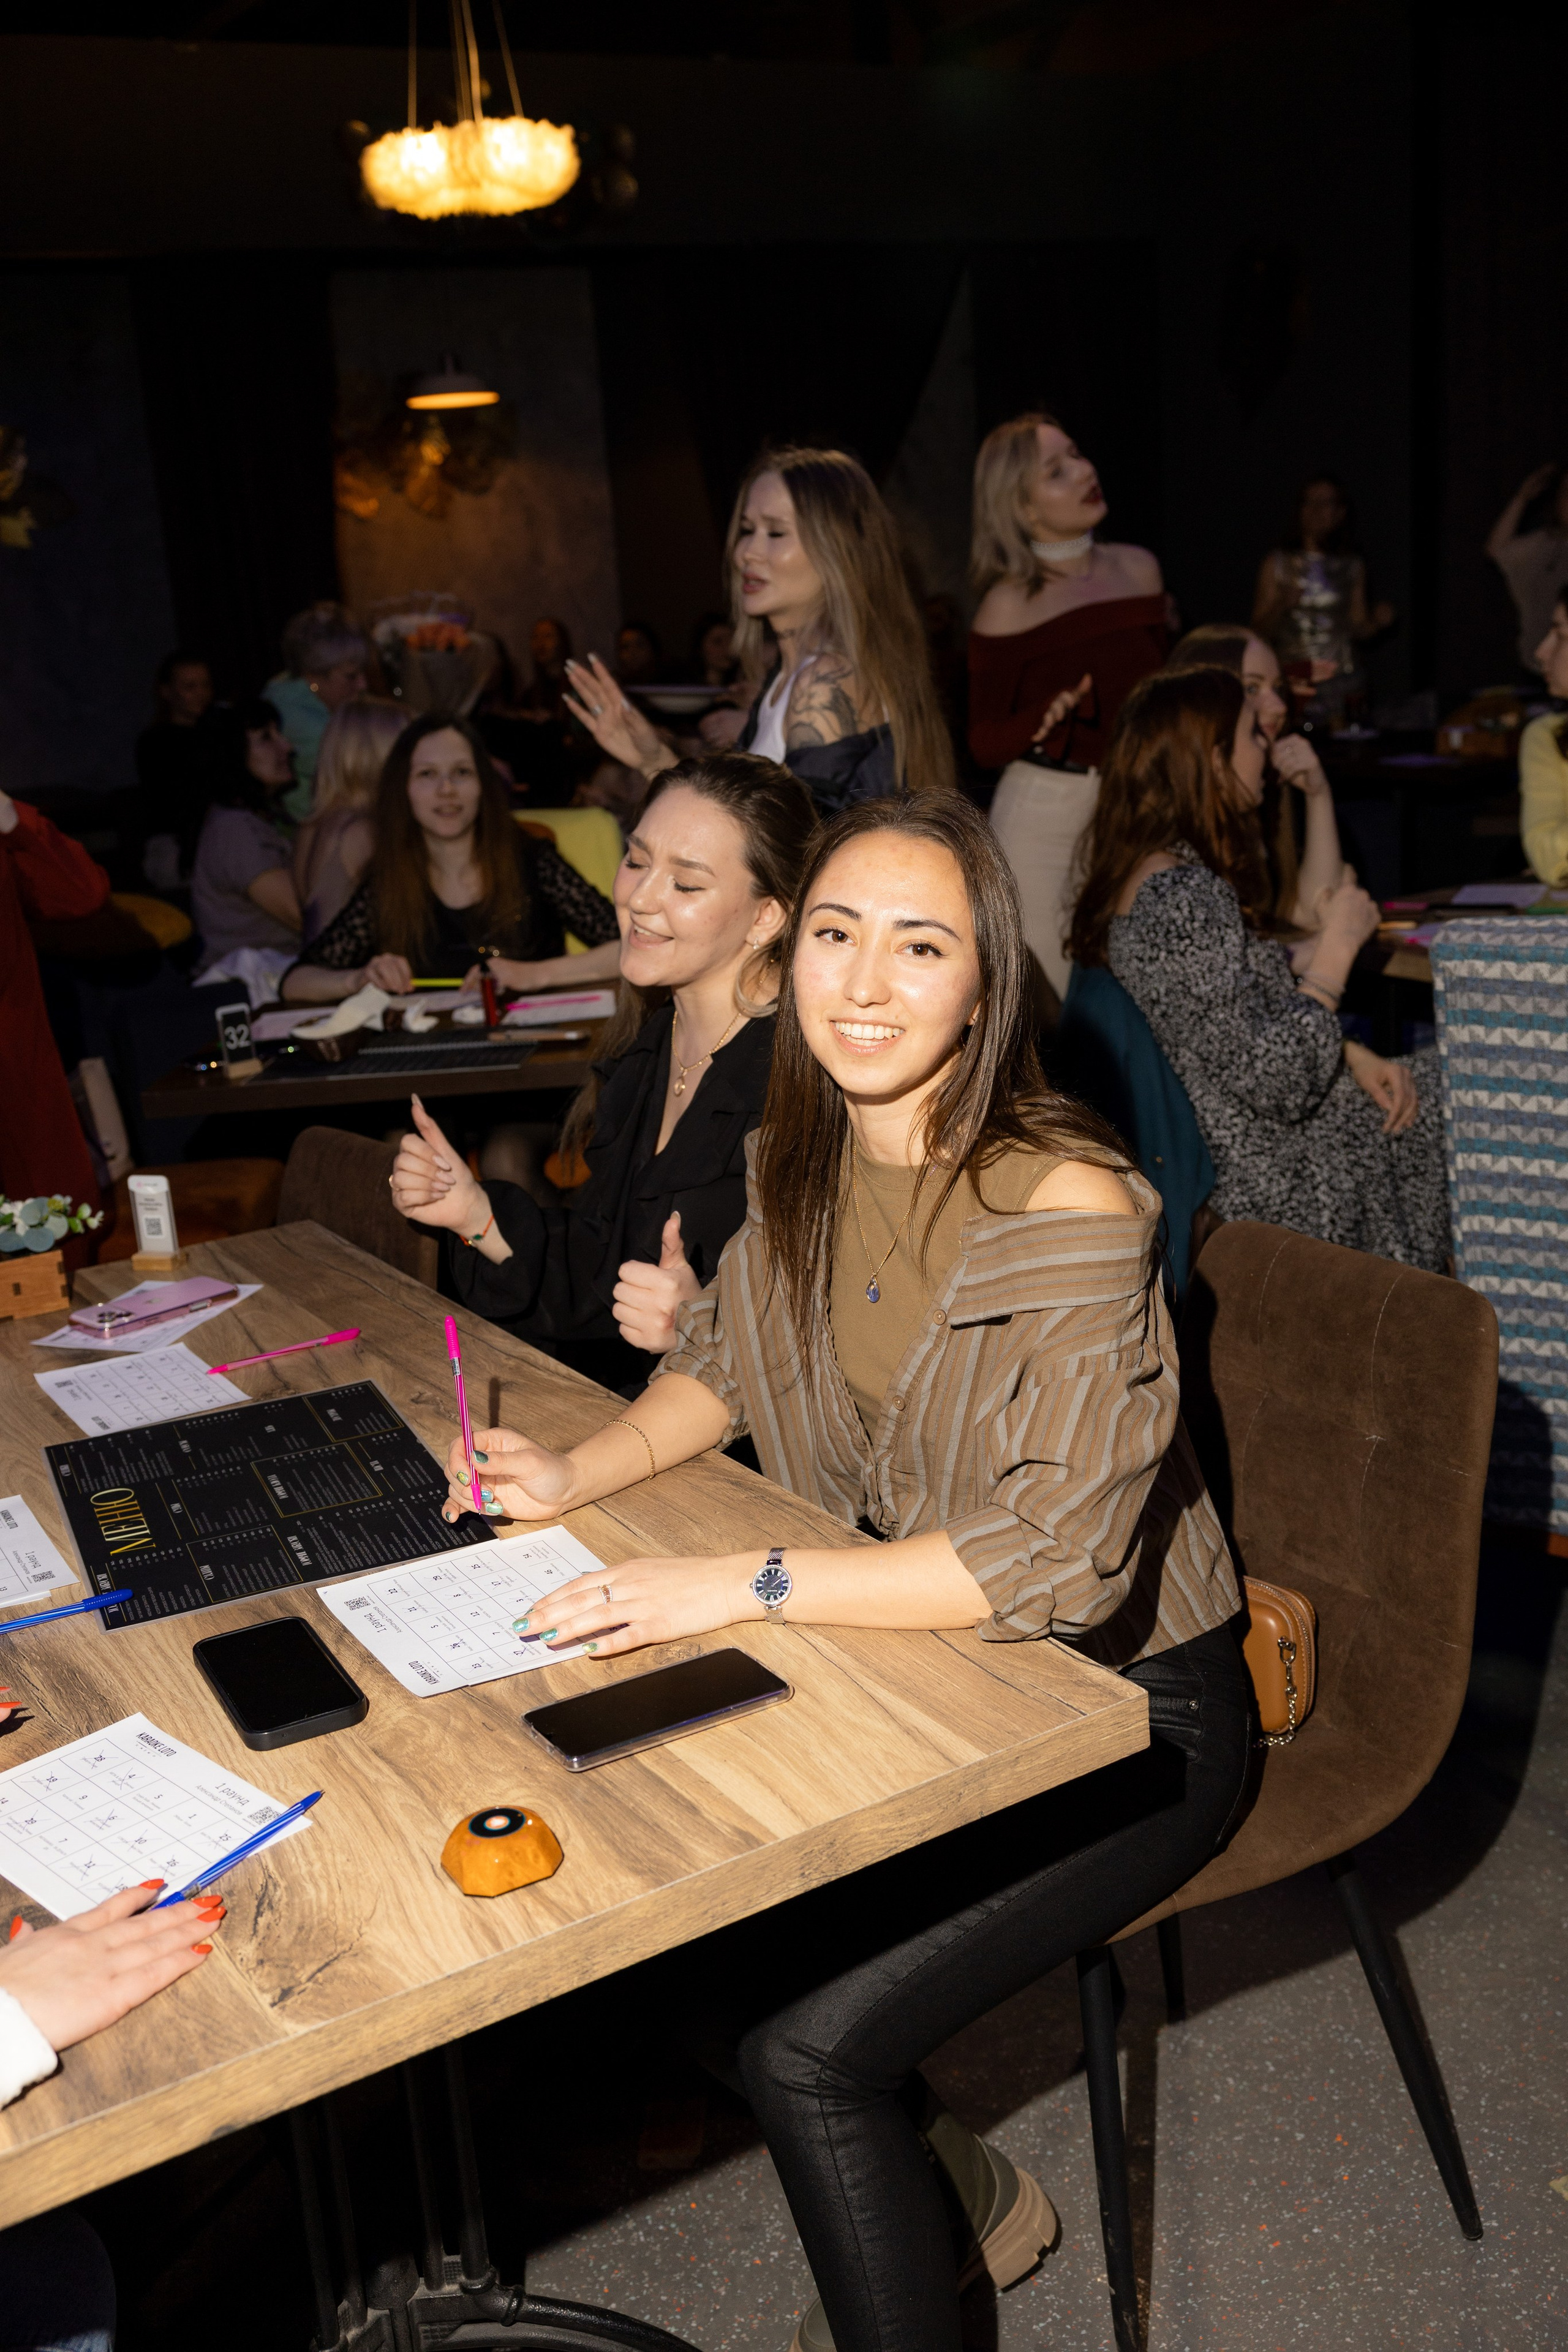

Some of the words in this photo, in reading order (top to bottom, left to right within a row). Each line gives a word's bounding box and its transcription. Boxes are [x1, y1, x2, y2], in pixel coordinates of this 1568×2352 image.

[224, 1023, 251, 1050] 32
[7, 1520, 18, 1529] LOTO
[90, 1488, 156, 1556] МЕНЮ
[287, 1536, 304, 1550] ЗАКУСКИ
[25, 1555, 41, 1569] раунд
[295, 1551, 312, 1566] ГОРЯЧИЕ
[199, 1564, 214, 1580] САЛАТЫ
[373, 1606, 388, 1619] Степанов
[364, 1613, 385, 1628] раунд
[386, 1618, 402, 1633] Александр
[409, 1660, 424, 1671] LOTO
[417, 1669, 440, 1684] KARAOKE
[136, 1732, 165, 1749] KARAOKE
[158, 1746, 176, 1757] LOTO
[196, 1785, 221, 1801] Александр
[219, 1800, 243, 1815] Степанов
[219, 1788, 249, 1806] раунд
[219, 1833, 232, 1842] 25
[166, 1858, 179, 1867] 26
